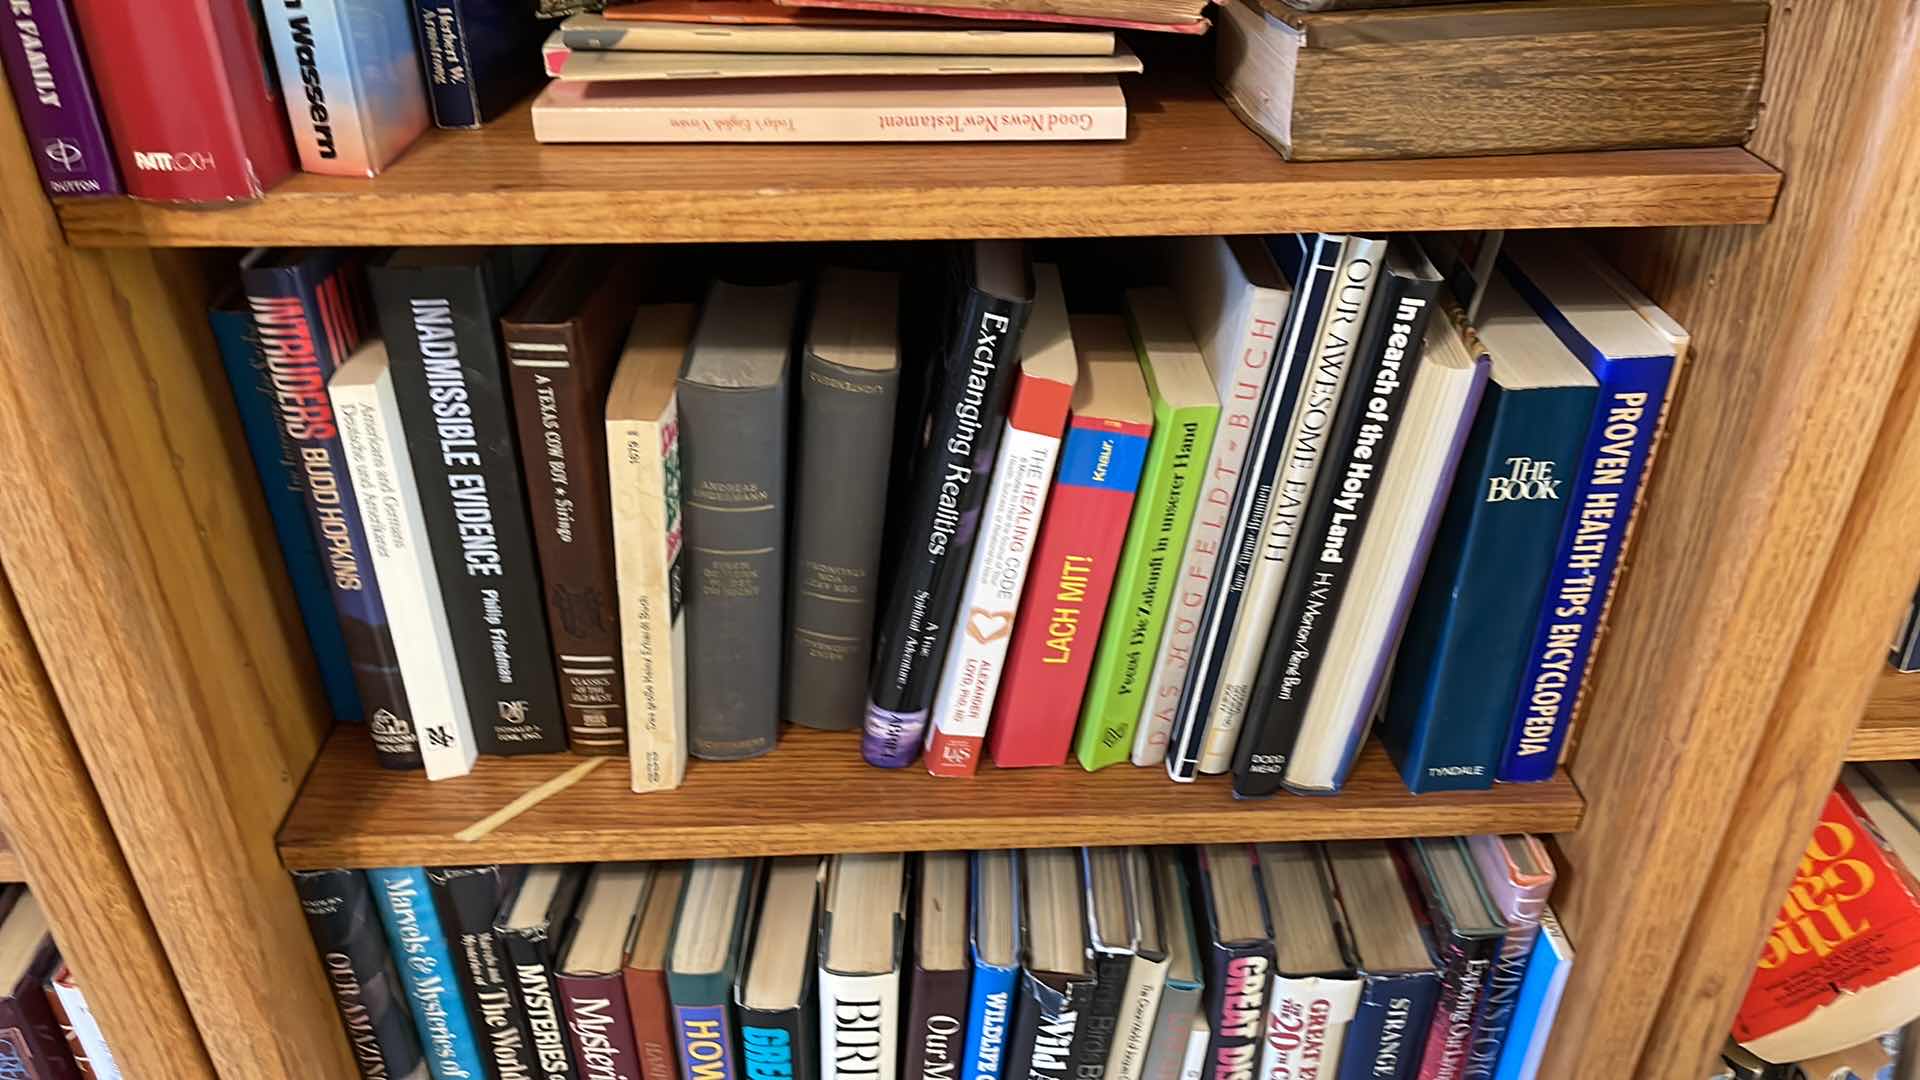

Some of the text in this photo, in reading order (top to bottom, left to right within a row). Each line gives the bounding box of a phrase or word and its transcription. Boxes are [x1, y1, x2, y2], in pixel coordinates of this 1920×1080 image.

[16, 20, 61, 107] FAMILY
[288, 16, 336, 159] Wassern
[670, 116, 795, 132] Today's English Version
[879, 113, 1094, 133] Good News New Testament
[51, 179, 100, 192] DUTTON
[1397, 297, 1427, 321] In
[248, 296, 337, 440] INTRUDERS
[534, 373, 551, 385] A
[947, 311, 1010, 456] Exchanging
[1373, 322, 1413, 396] search
[537, 387, 560, 430] TEXAS
[1264, 258, 1372, 562] OUR AWESOME EARTH
[1365, 402, 1389, 424] of
[545, 431, 564, 459] COW
[1026, 449, 1049, 479] THE
[1354, 424, 1384, 461] the
[1505, 457, 1556, 482] THE
[301, 447, 340, 504] BUDD
[410, 299, 481, 466] INADMISSIBLE
[448, 474, 503, 576] EVIDENCE
[489, 628, 513, 683] Friedman
[549, 460, 568, 486] BOY
[1332, 462, 1372, 516] Holy
[1486, 478, 1562, 502] BOOK
[927, 464, 972, 556] Realities
[1010, 484, 1039, 552] HEALING
[1136, 557, 1165, 616] Zukunft
[1152, 537, 1169, 553] in
[1161, 475, 1185, 532] unserer
[1173, 422, 1199, 468] Hand
[1320, 512, 1357, 563] Land
[317, 507, 363, 591] HOPKINS
[998, 557, 1021, 600] CODE
[1517, 391, 1648, 757] PROVEN HEALTH-TIPS ENCYCLOPEDIA
[908, 590, 931, 632] Spiritual
[926, 621, 940, 632] A
[1042, 555, 1094, 664] LACH MIT!
[968, 659, 992, 719] ALEXANDER
[1148, 685, 1179, 746] DAS
[1428, 765, 1485, 777] TYNDALE
[384, 876, 471, 1079] Marvels & Mysteries of
[477, 987, 512, 1027] The
[1219, 956, 1269, 1038] GREAT
[325, 952, 390, 1080] OUR AMAZIN
[515, 964, 569, 1072] MYSTERIES
[926, 1015, 961, 1060] Our
[976, 992, 1008, 1072] WILDLIFE
[1031, 1010, 1079, 1070] Wild
[1302, 999, 1331, 1063] GREAT
[1372, 997, 1412, 1076] STRANGE
